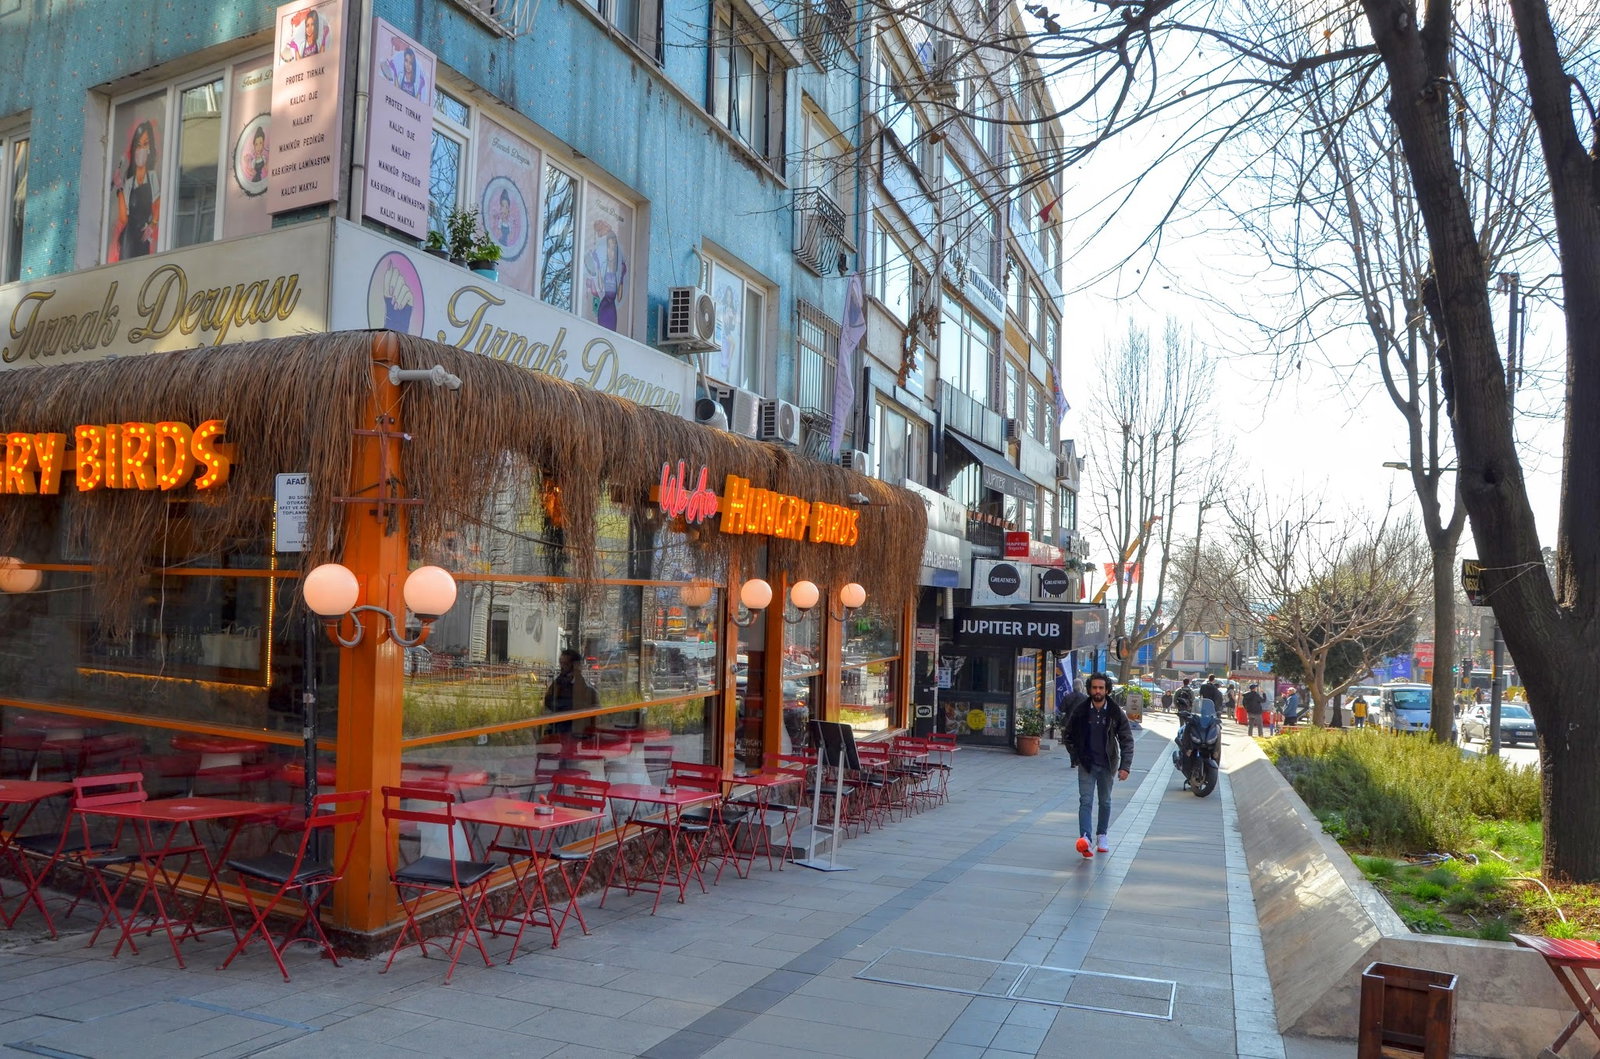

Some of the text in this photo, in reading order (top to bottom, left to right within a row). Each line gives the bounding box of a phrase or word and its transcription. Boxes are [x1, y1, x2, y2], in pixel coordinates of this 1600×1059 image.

[285, 73, 304, 86] PROTEZ
[306, 67, 325, 79] TIRNAK
[289, 91, 319, 106] KALICI OJE
[385, 95, 421, 122] PROTEZ TIRNAK
[407, 128, 416, 141] OJE
[298, 181, 318, 194] MAKYAJ
[2, 280, 120, 363] Tırnak
[0, 419, 230, 494] RY BIRDS
[659, 458, 860, 547] We Are HUNGRY BIRDS
[960, 619, 1023, 636] JUPITER
[1027, 622, 1060, 637] PUB
